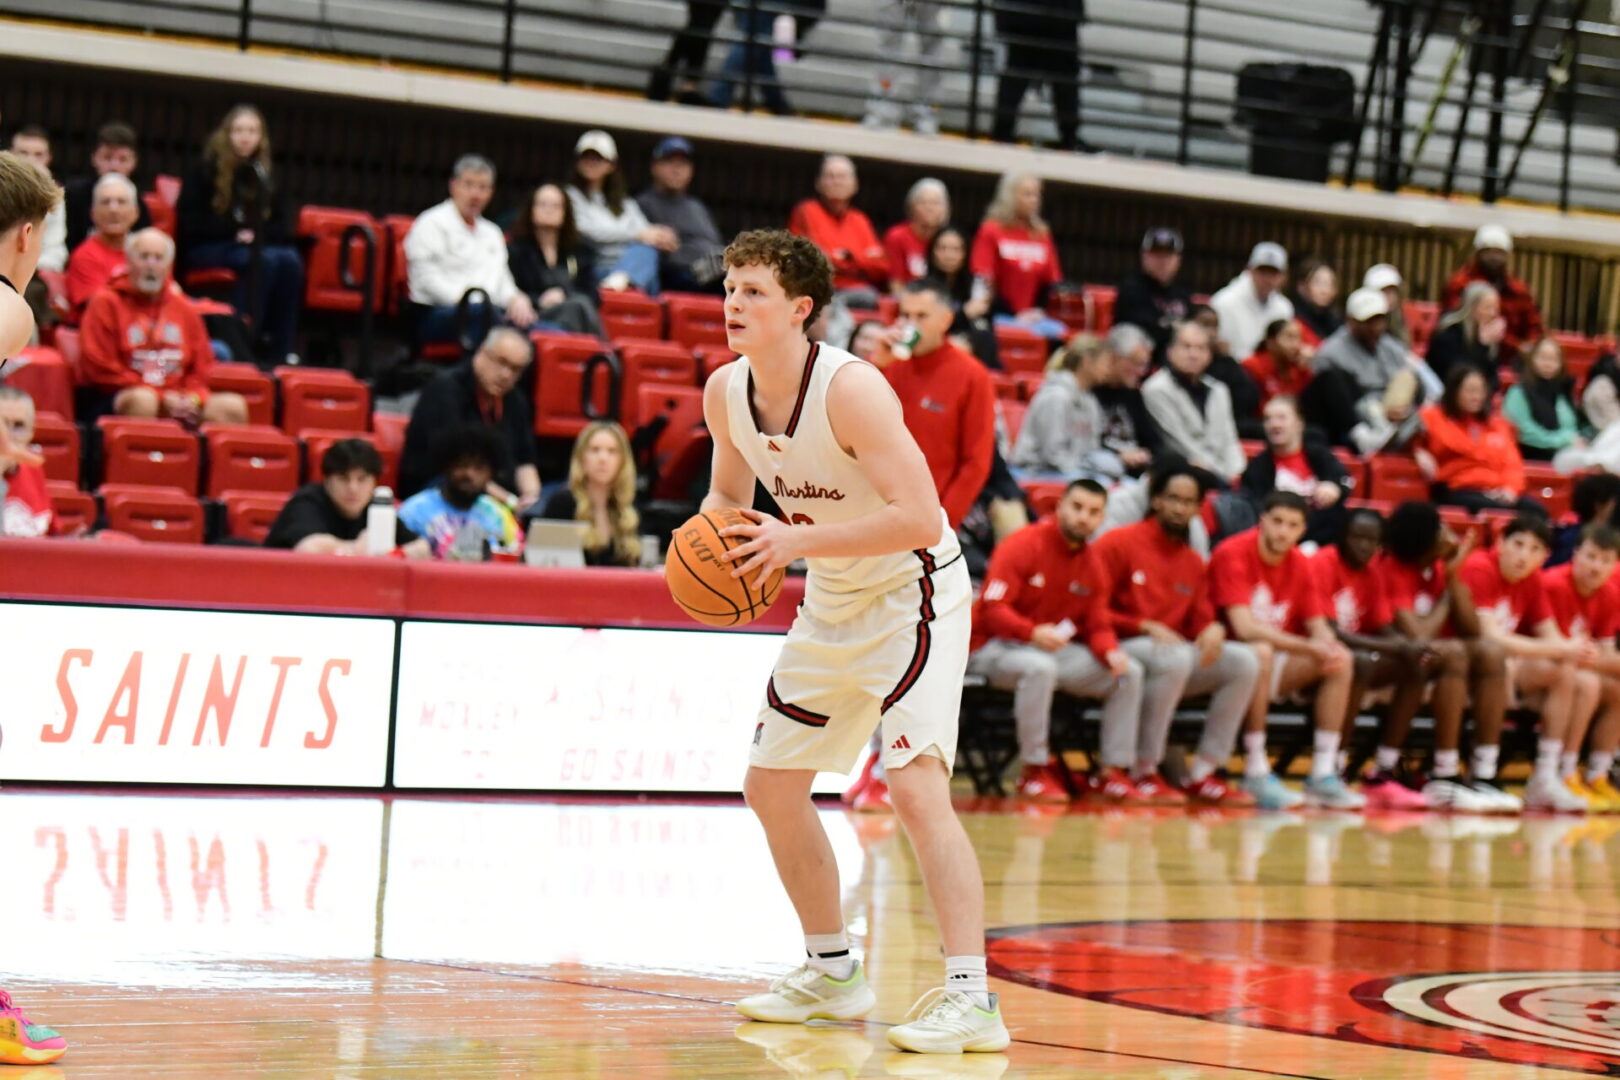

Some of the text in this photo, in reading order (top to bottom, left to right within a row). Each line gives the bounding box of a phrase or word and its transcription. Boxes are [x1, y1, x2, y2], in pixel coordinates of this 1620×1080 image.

[40, 648, 352, 748] SAINTS
[560, 748, 716, 782] GO SAINTS
